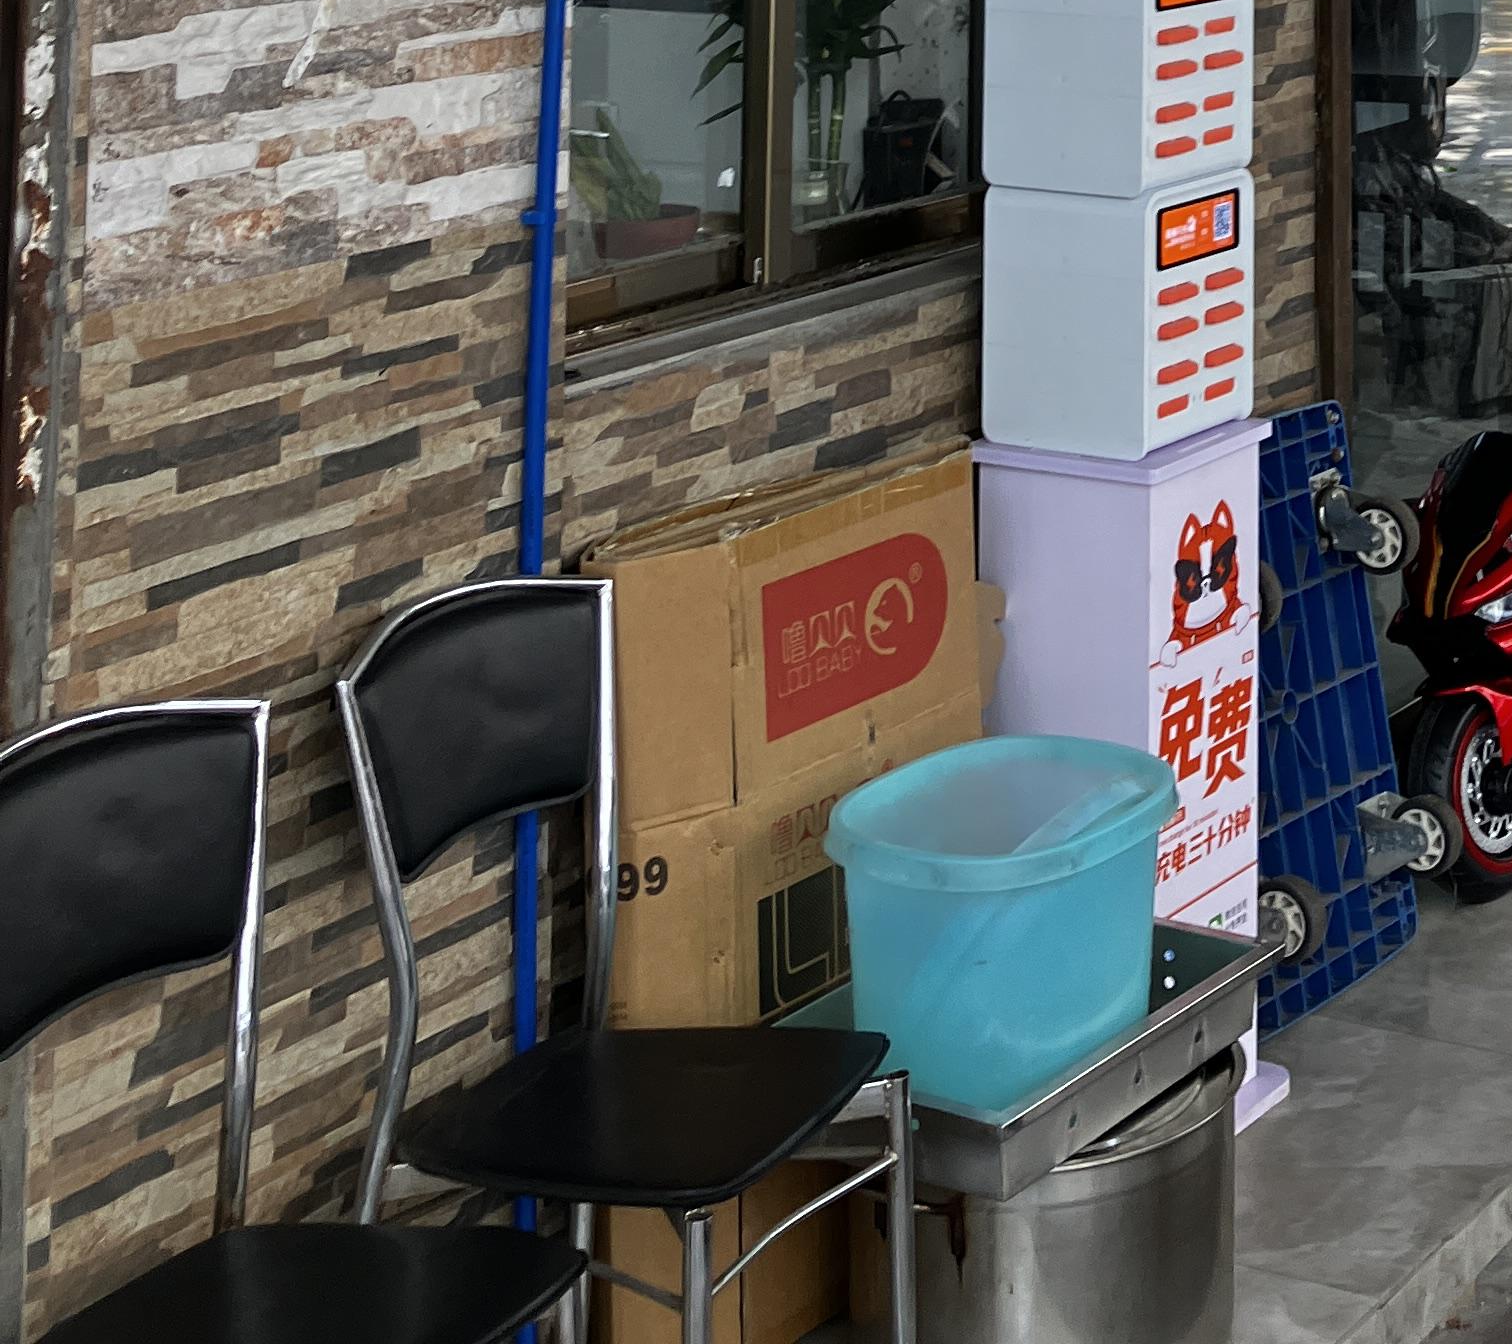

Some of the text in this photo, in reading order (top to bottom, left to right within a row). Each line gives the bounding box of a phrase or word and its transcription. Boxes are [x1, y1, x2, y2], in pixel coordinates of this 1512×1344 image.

[1158, 675, 1254, 801] 免费
[1154, 804, 1252, 887] 充电三十分钟
